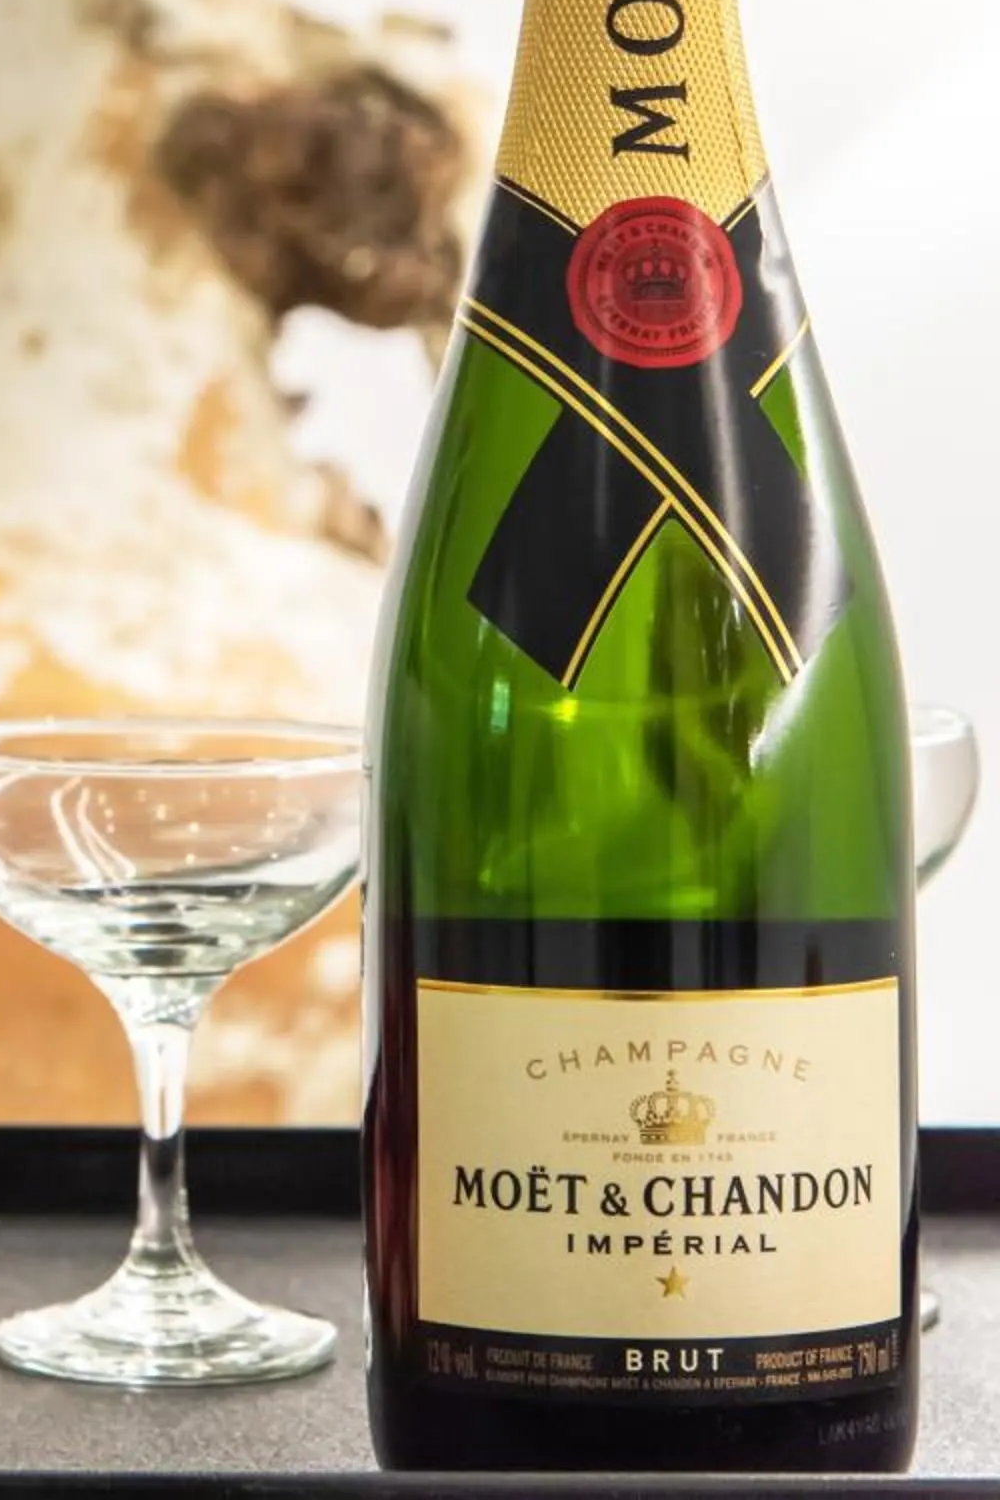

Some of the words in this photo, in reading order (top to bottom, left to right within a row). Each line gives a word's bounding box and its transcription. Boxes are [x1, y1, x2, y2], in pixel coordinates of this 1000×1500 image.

[525, 1040, 811, 1082] CHAMPAGNE
[716, 1131, 777, 1143] FRANCE
[671, 1151, 691, 1163] EN
[452, 1165, 588, 1215] MOËT
[599, 1182, 631, 1218] &
[643, 1164, 874, 1217] CHANDON
[566, 1230, 778, 1256] IMPÉRIAL
[551, 1353, 596, 1372] FRANCE
[625, 1347, 725, 1373] BRUT
[755, 1350, 804, 1370] PRODUCT
[805, 1348, 819, 1366] OF
[820, 1344, 854, 1363] FRANCE
